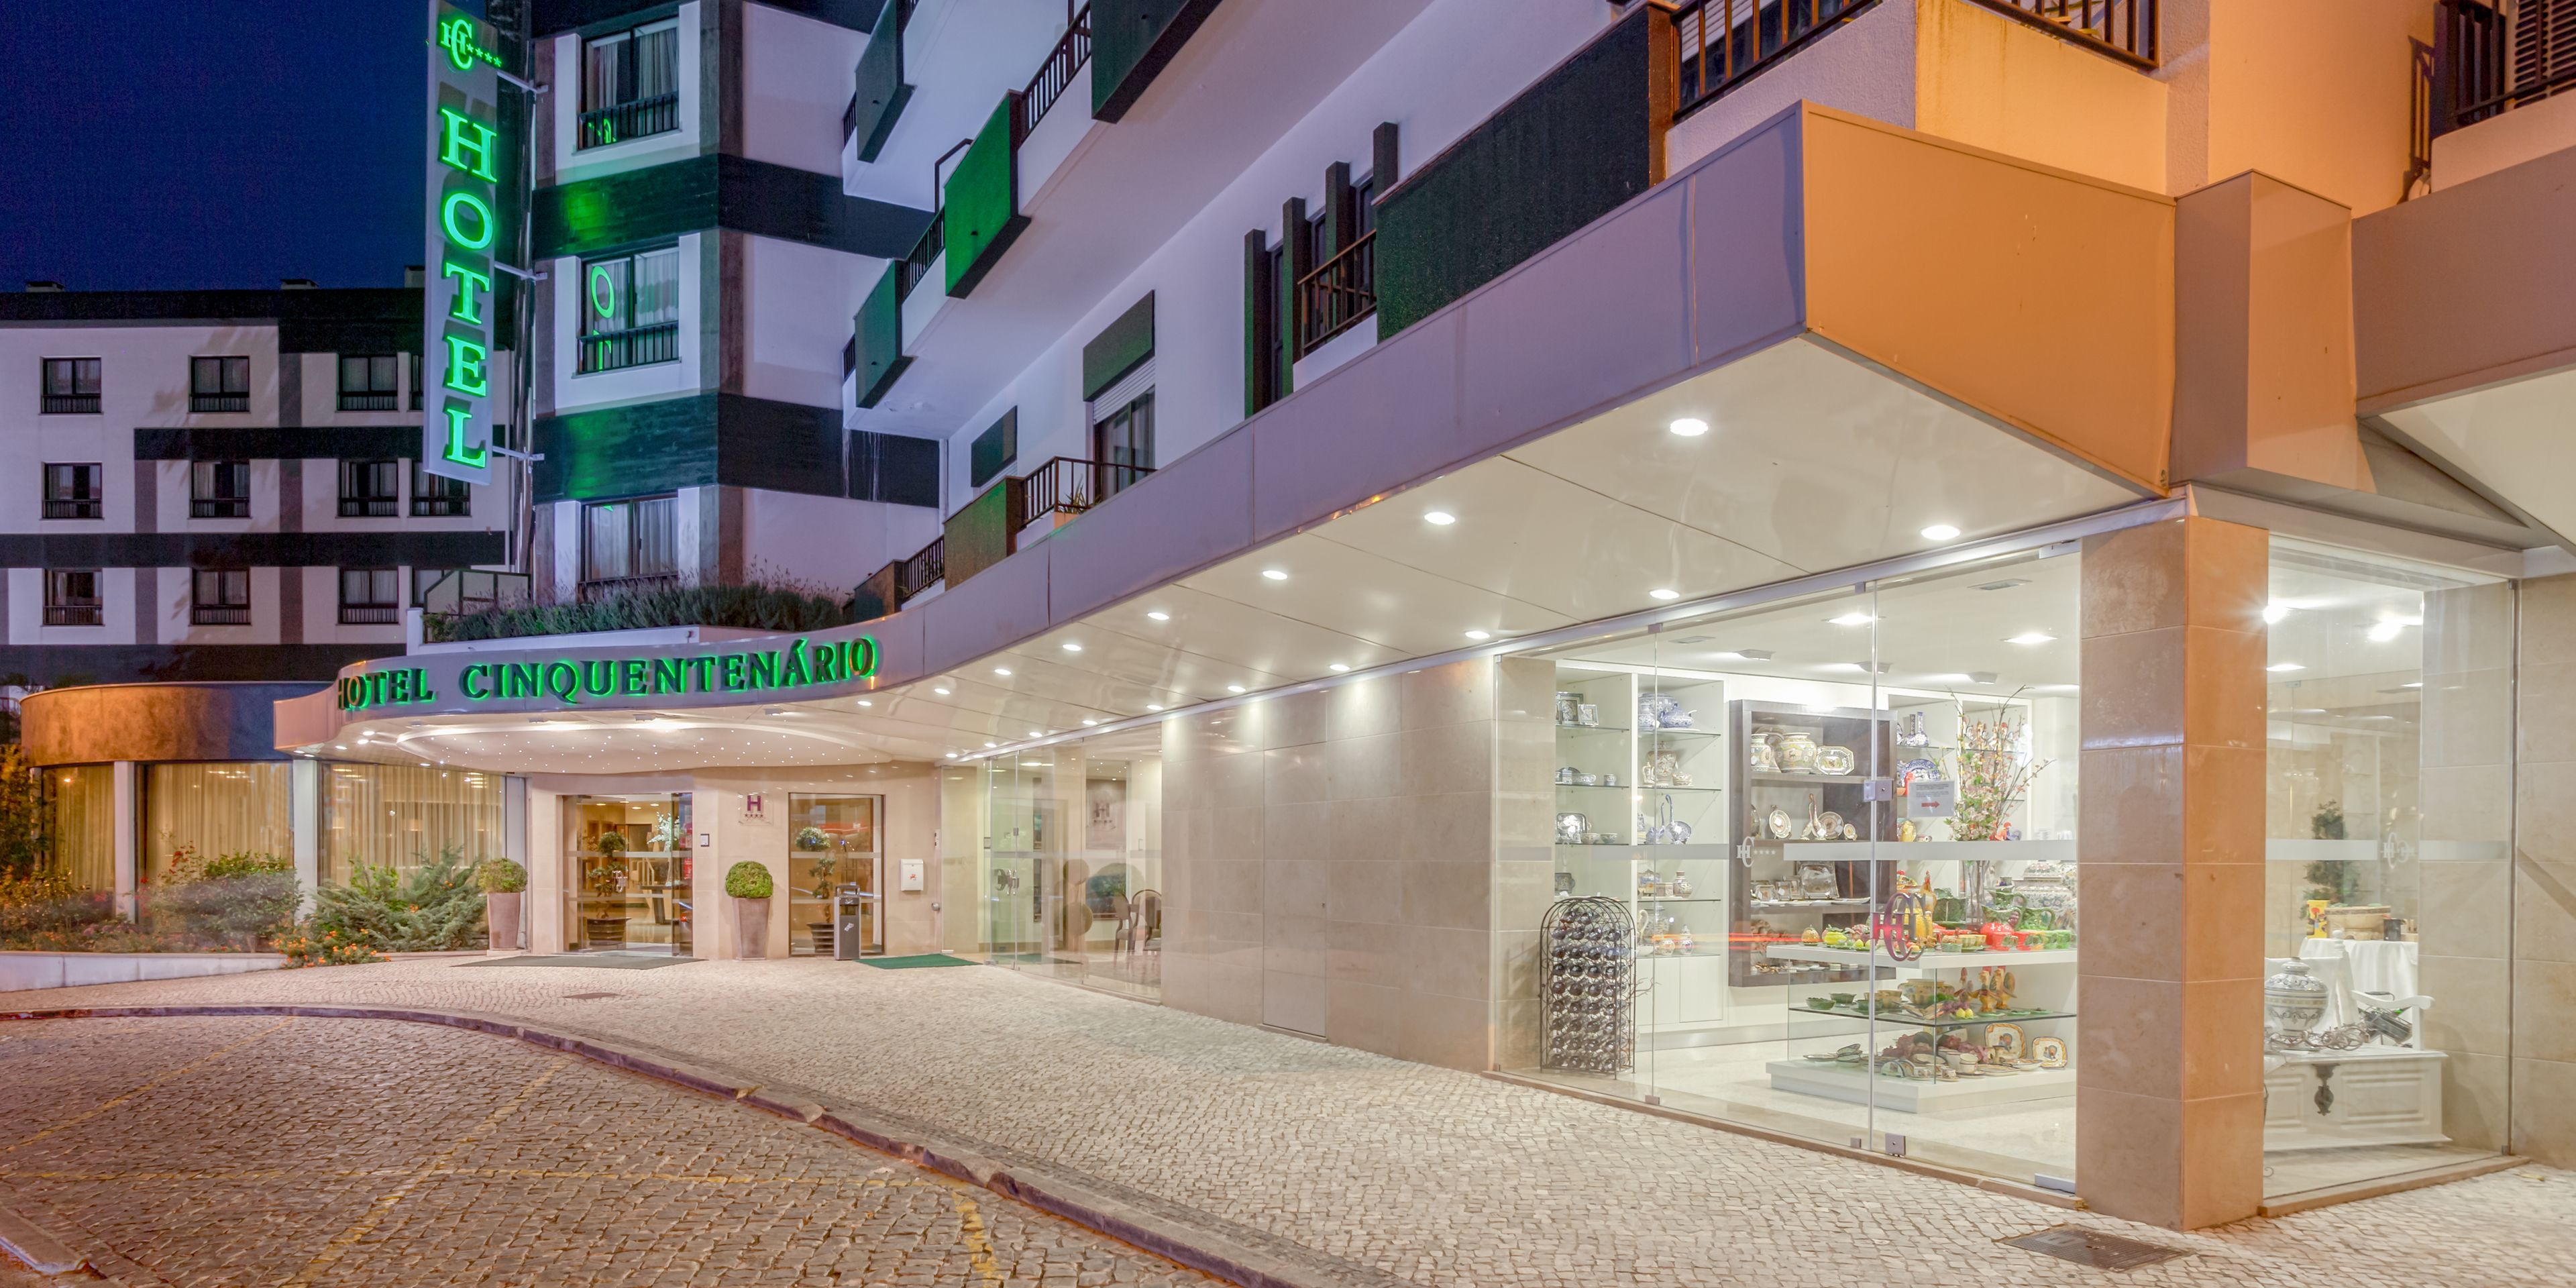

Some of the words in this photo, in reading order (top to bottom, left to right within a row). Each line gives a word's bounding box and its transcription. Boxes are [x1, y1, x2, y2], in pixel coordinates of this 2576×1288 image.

[441, 109, 497, 468] HOTEL
[337, 668, 436, 710] HOTEL
[459, 637, 878, 704] CINQUENTENÁRIO
[747, 795, 761, 812] H
